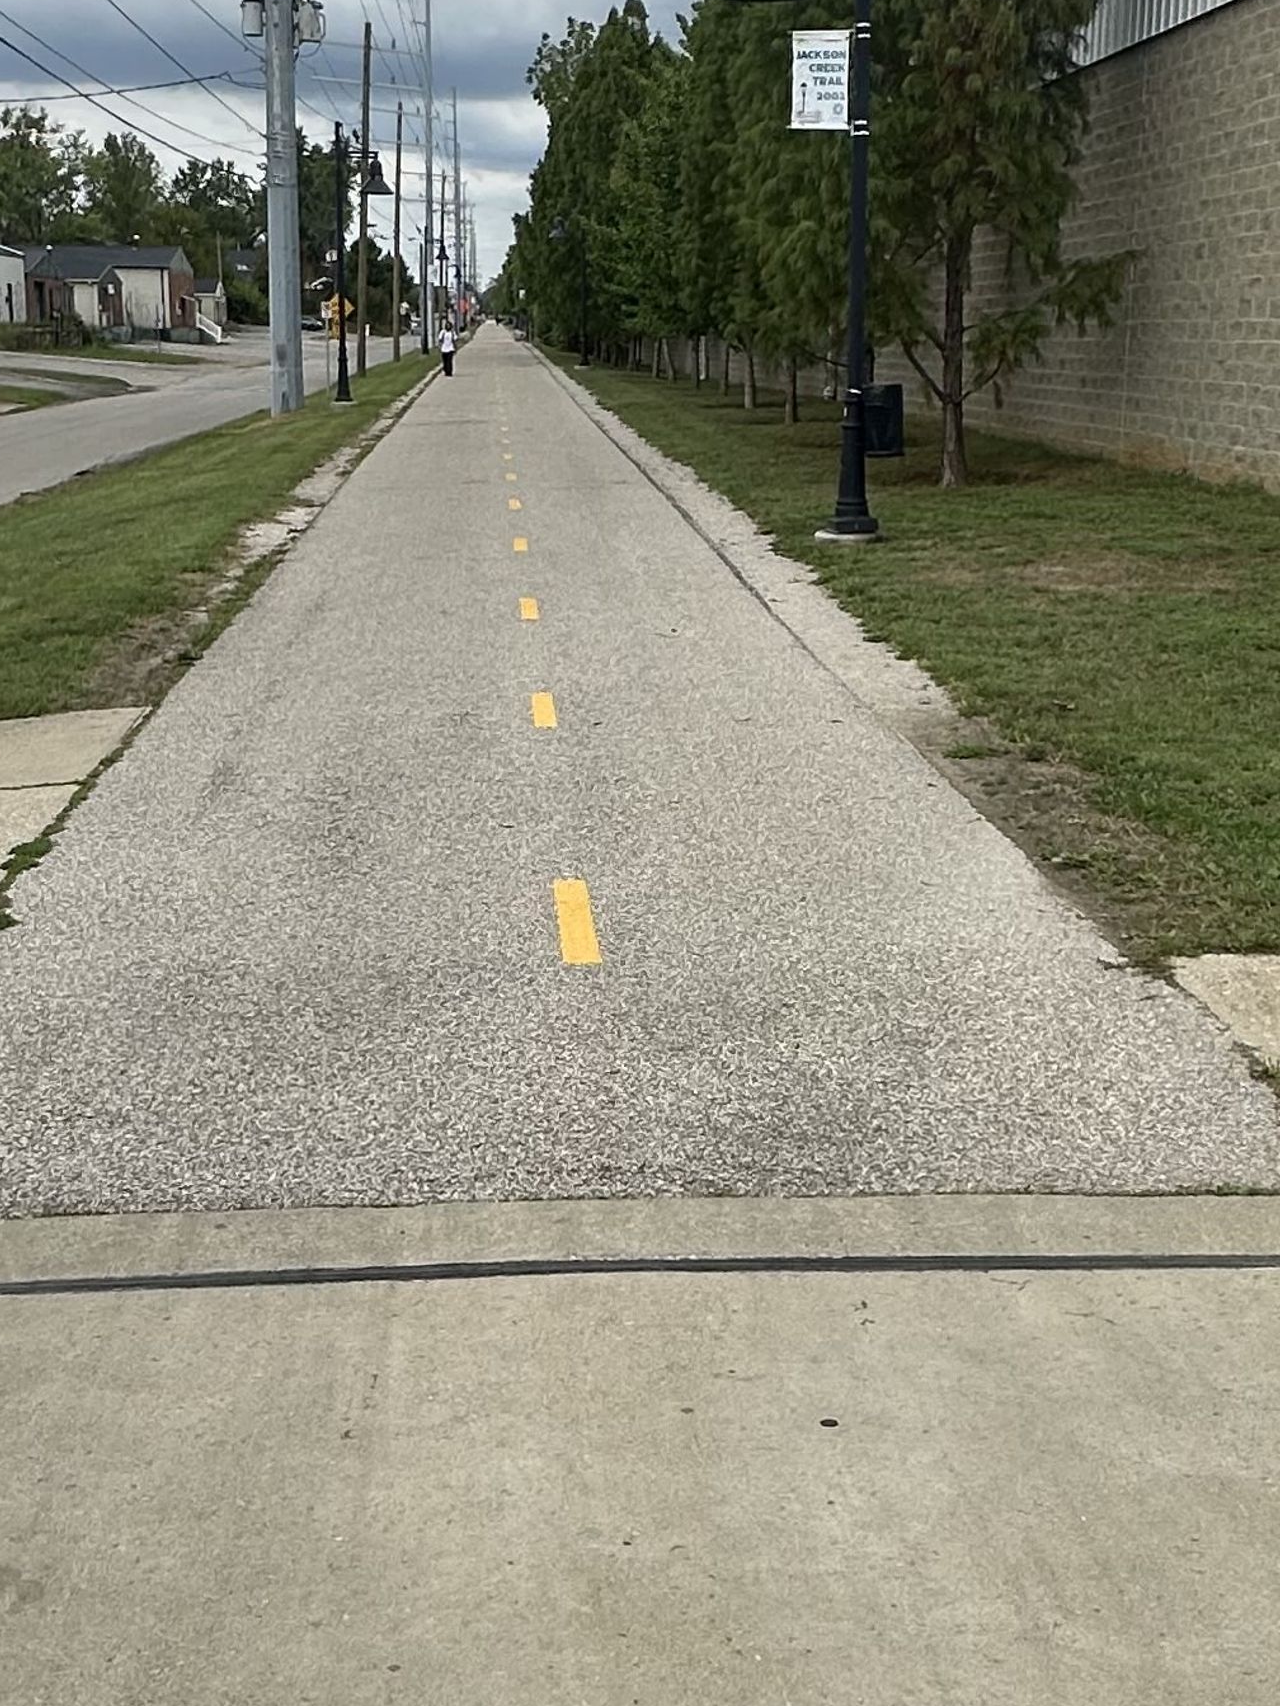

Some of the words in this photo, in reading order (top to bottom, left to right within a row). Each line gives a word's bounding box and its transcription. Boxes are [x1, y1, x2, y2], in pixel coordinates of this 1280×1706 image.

[797, 50, 846, 59] JACKSON
[809, 63, 845, 72] CREEK
[812, 76, 843, 85] TRAIL
